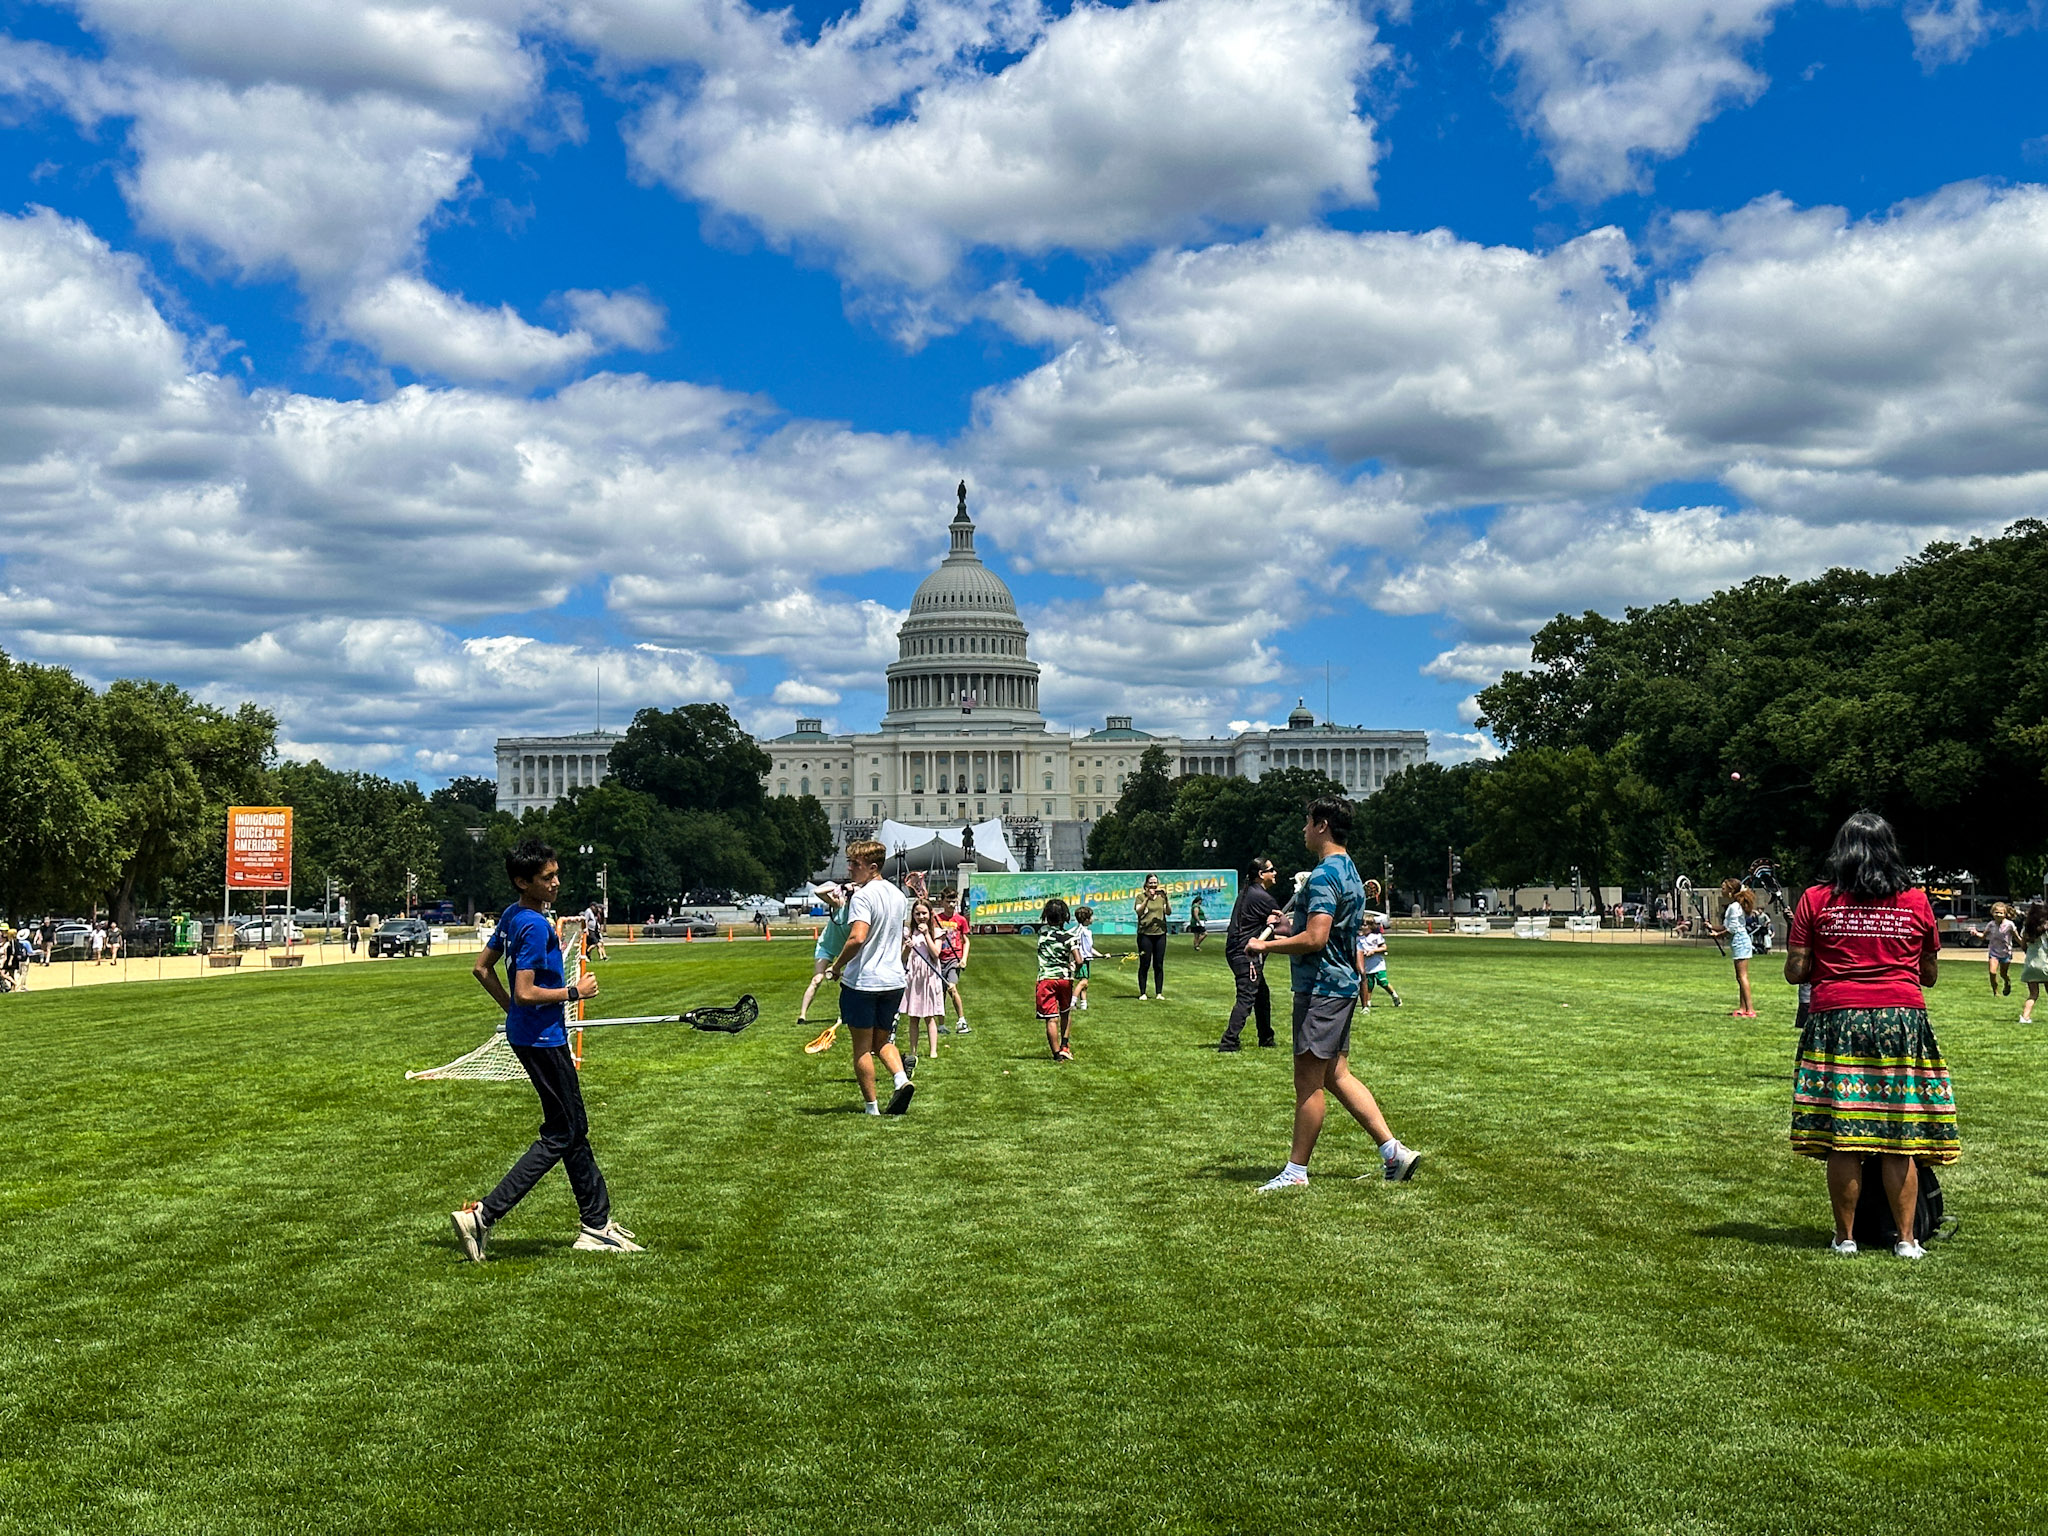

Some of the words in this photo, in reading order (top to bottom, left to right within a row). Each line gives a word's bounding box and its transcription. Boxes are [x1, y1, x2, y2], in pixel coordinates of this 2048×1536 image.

[235, 814, 285, 826] INDIGENOUS
[235, 827, 264, 838] VOICES
[274, 829, 284, 837] THE
[235, 839, 277, 851] AMERICAS
